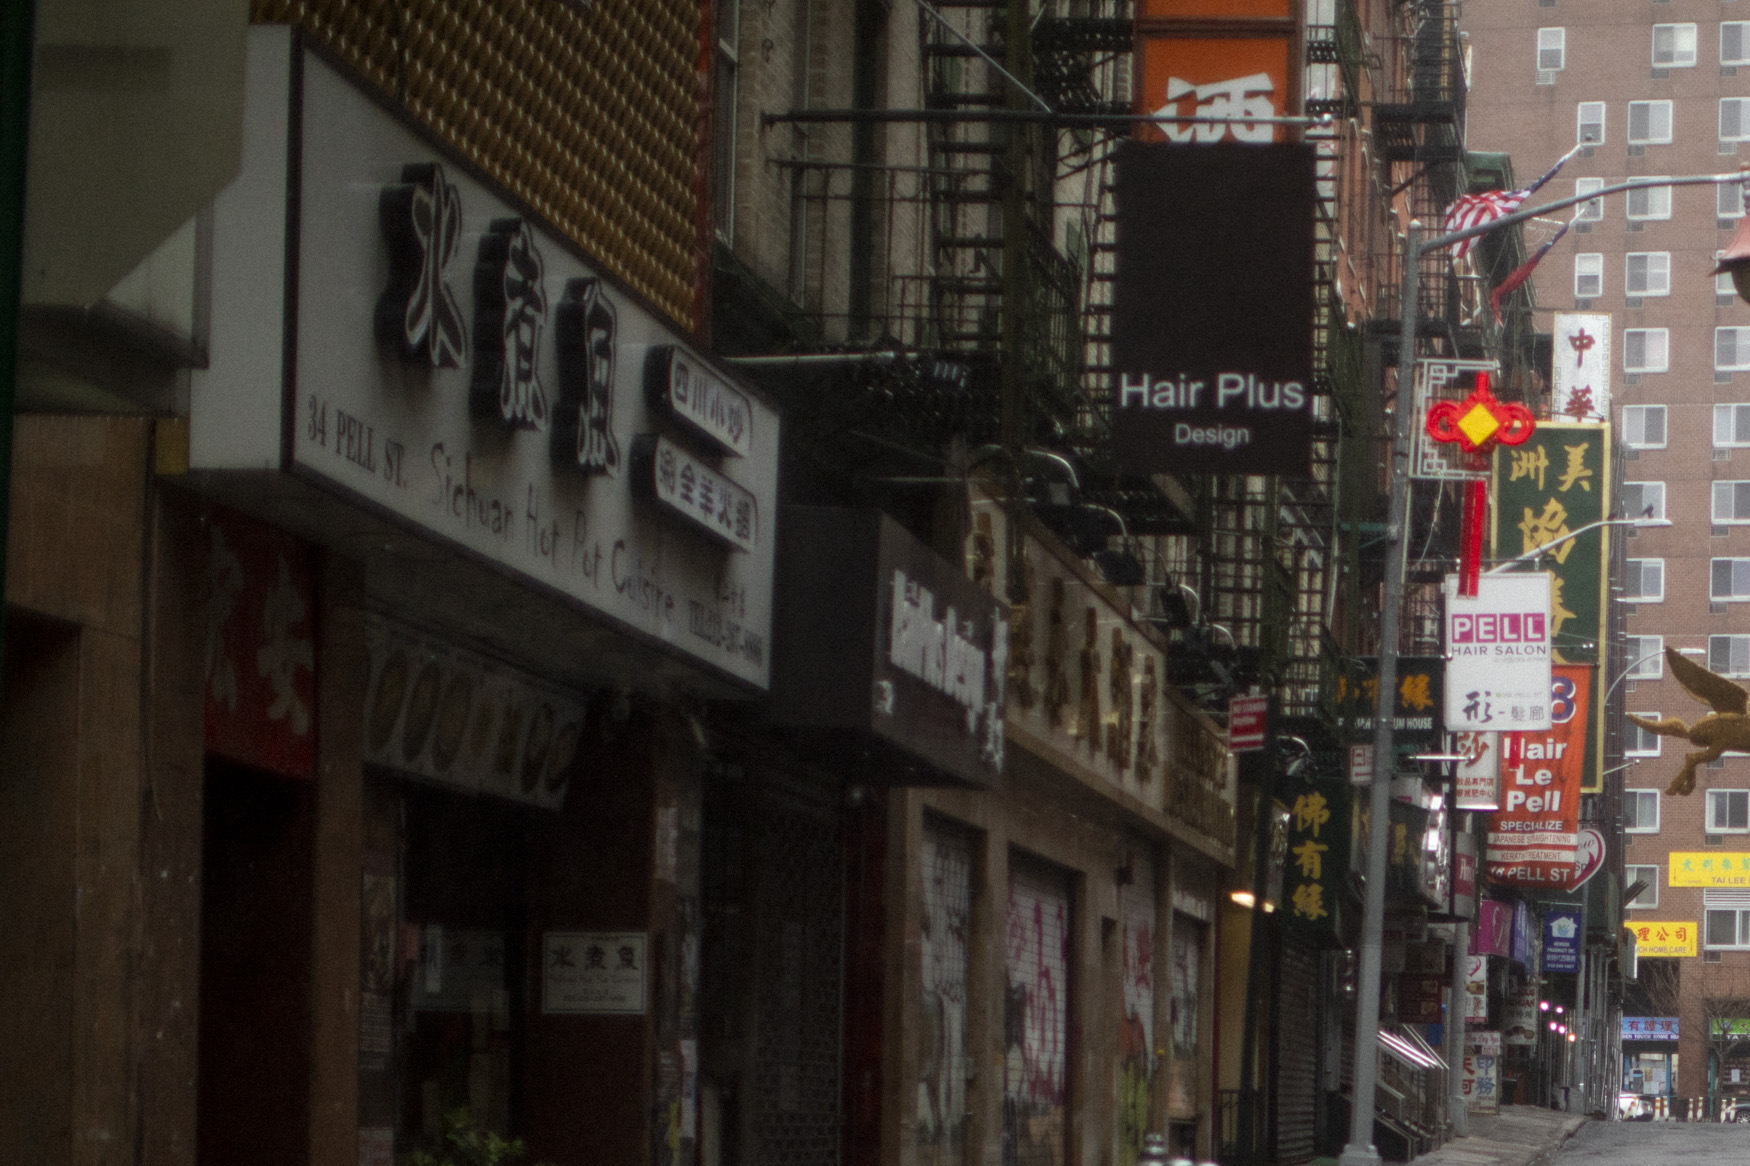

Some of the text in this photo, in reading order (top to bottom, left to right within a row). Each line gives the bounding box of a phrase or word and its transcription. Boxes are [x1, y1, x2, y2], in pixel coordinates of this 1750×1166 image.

[1119, 373, 1305, 409] Hair Plus
[308, 394, 408, 490] 34 PELL ST.
[1174, 423, 1251, 448] Design
[526, 482, 559, 568] Hot
[1453, 616, 1543, 641] PELL
[1452, 645, 1547, 656] HAIR SALON
[1406, 717, 1433, 729] HOUSE
[1503, 737, 1568, 760] Hair
[1515, 764, 1553, 786] Le
[1506, 790, 1561, 813] Pell
[1500, 819, 1563, 832] SPECIALIZE
[1493, 835, 1525, 844] JAPANESE
[1292, 791, 1331, 921] 佛有緣
[1507, 866, 1546, 881] PELL
[1549, 867, 1571, 882] ST
[1712, 877, 1726, 885] TAI
[1728, 877, 1746, 885] LEE
[1649, 946, 1668, 954] HOME
[1669, 946, 1687, 954] CARE
